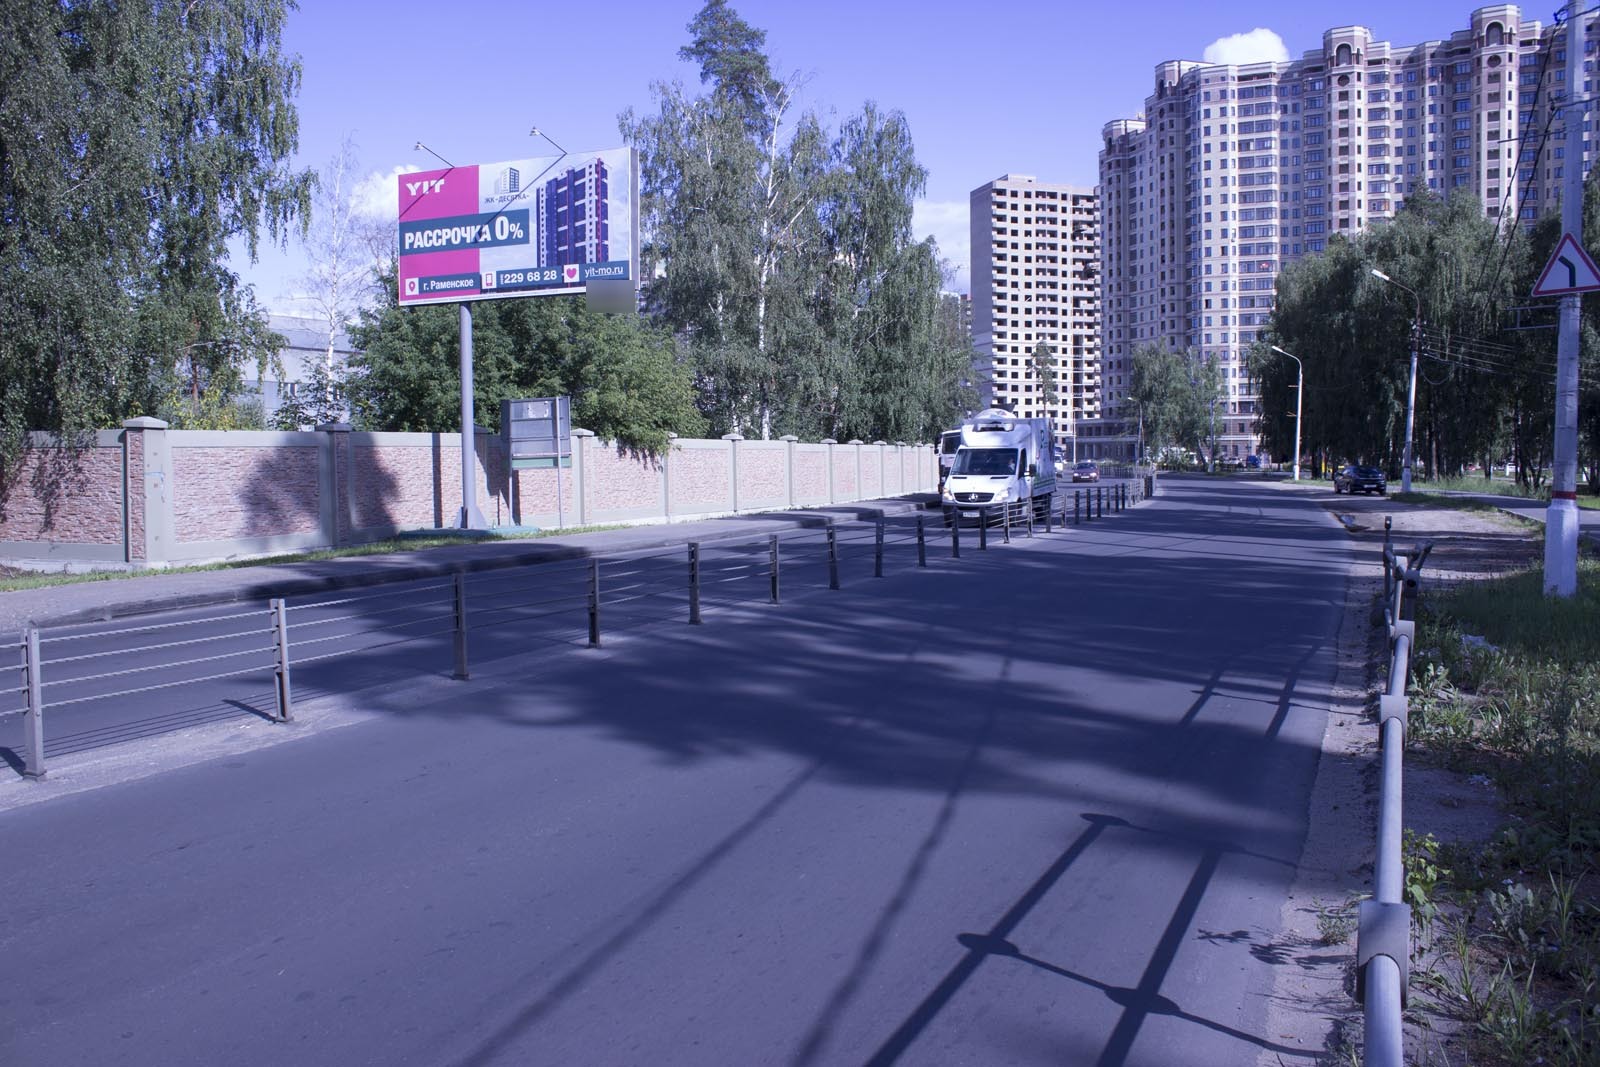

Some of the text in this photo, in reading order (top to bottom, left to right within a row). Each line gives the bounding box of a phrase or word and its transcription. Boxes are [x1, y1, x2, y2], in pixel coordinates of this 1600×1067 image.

[405, 178, 445, 196] YIT
[485, 196, 495, 204] ЖК
[404, 215, 524, 250] РАССРОЧКА 0%
[504, 272, 524, 284] 229
[527, 271, 541, 283] 68
[543, 270, 557, 282] 28
[584, 265, 624, 278] yit-mo.ru
[423, 278, 474, 291] г. Раменское
